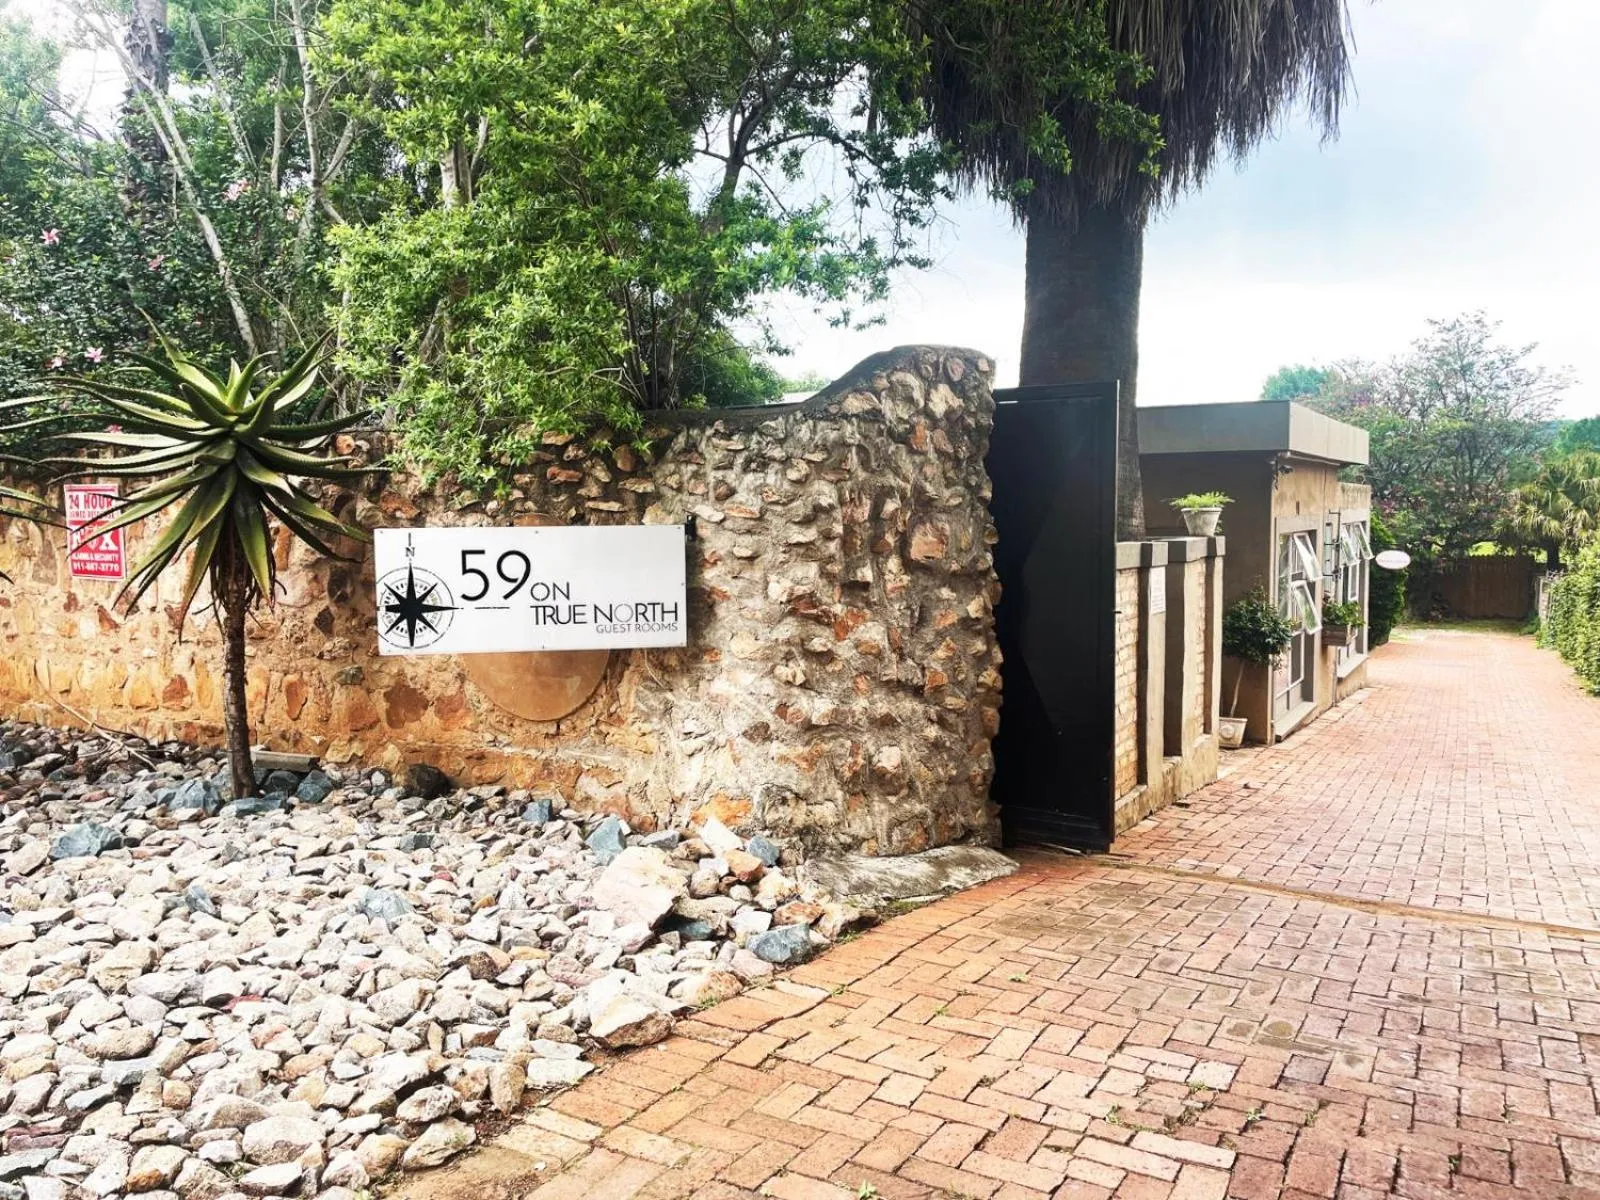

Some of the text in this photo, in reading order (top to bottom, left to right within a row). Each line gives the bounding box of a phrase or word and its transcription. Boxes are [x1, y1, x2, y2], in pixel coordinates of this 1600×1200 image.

[69, 494, 112, 509] 24 HOUR
[405, 547, 415, 557] N
[460, 549, 570, 602] 59 ON
[530, 602, 678, 625] TRUE NORTH
[596, 622, 678, 634] GUEST ROOMS
